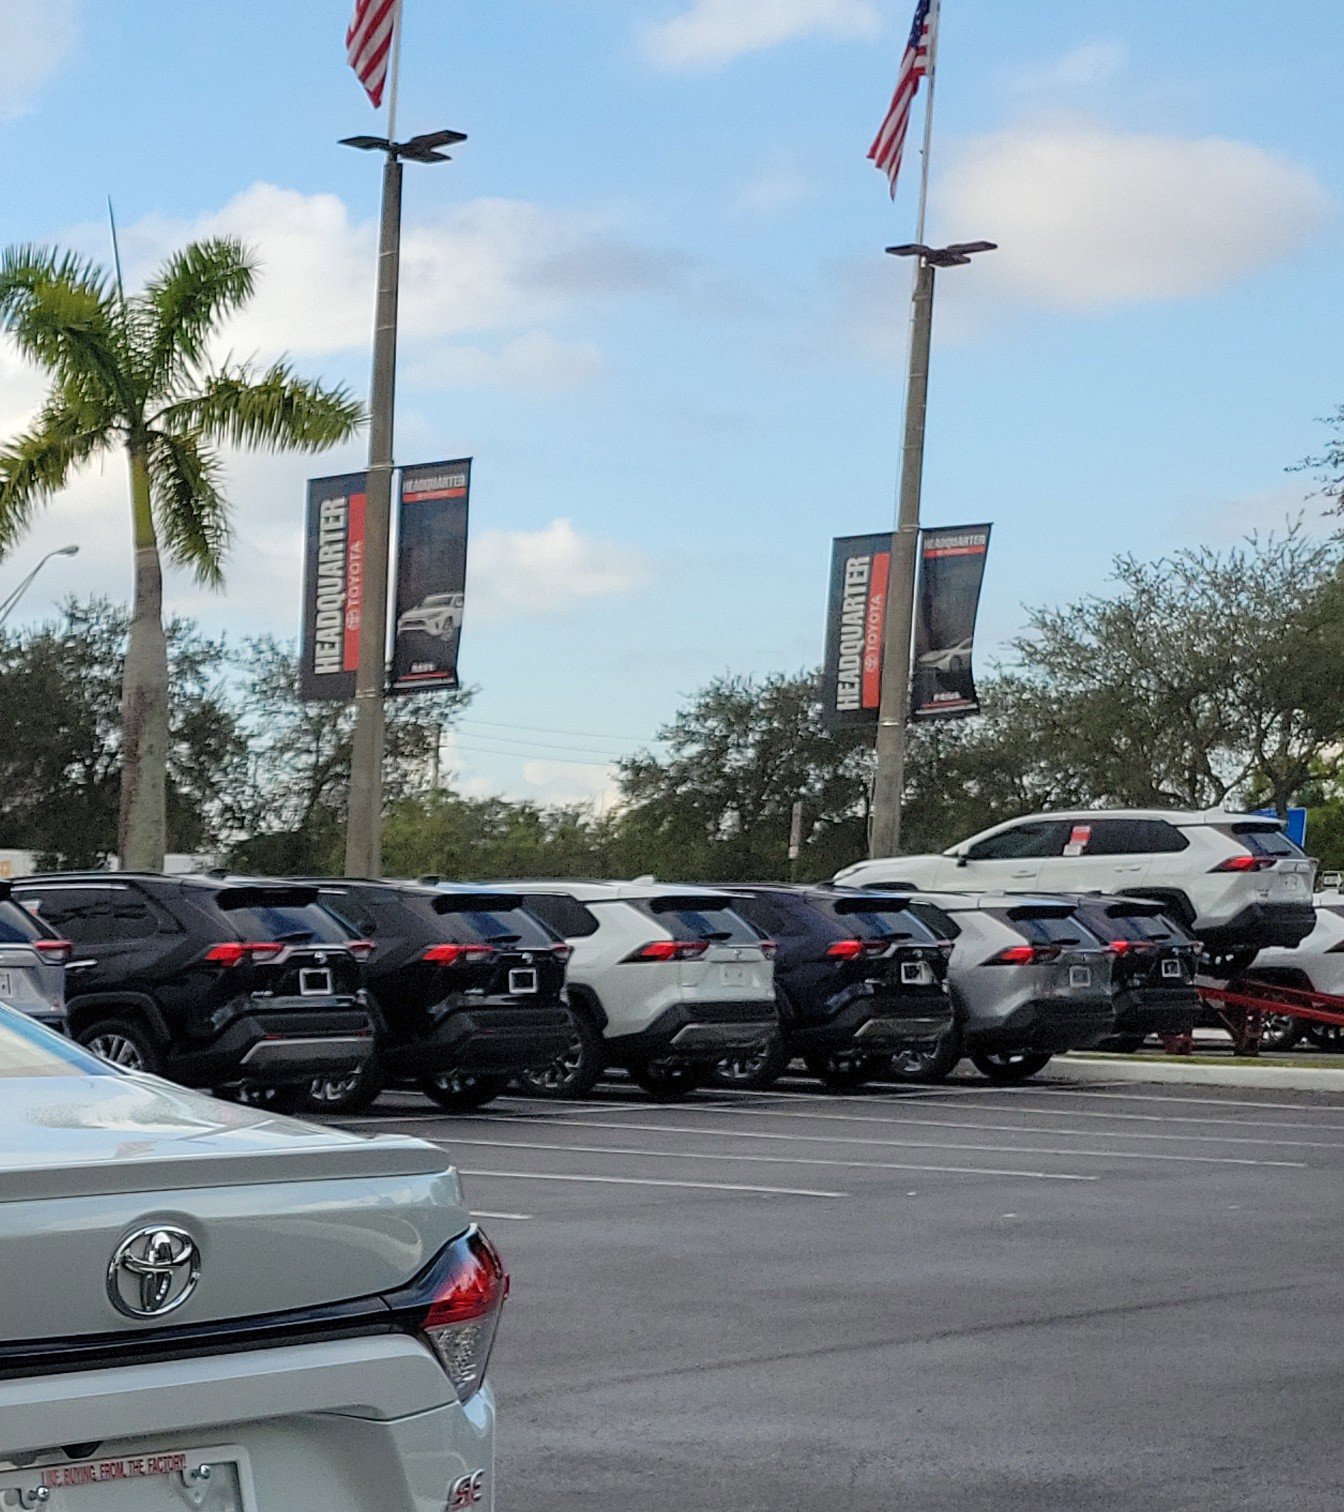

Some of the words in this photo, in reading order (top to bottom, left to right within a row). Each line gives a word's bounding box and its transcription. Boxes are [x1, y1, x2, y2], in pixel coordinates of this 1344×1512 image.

[314, 496, 348, 674] HEADQUARTER
[347, 540, 363, 606] TOYOTA
[836, 556, 871, 710] HEADQUARTER
[866, 592, 882, 654] TOYOTA
[100, 1461, 127, 1480] FROM
[128, 1458, 146, 1477] THE
